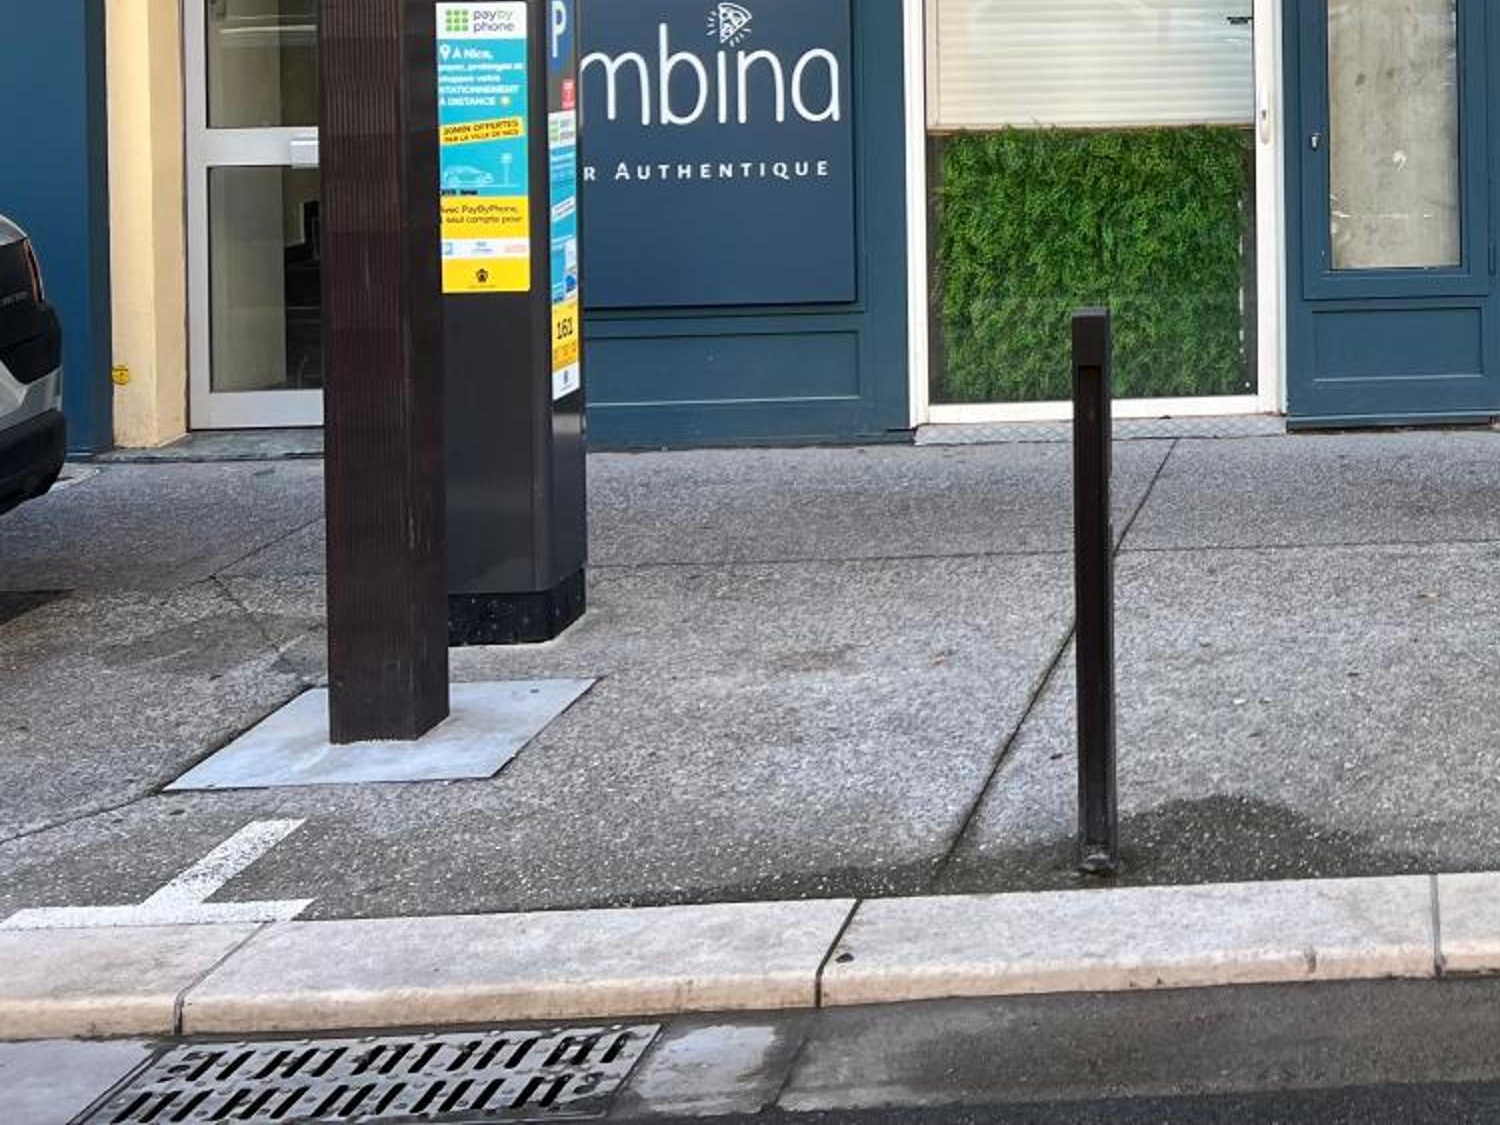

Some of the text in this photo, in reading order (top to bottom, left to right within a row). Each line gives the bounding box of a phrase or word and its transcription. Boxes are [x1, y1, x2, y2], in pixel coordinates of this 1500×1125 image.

[473, 21, 516, 34] phone
[551, 0, 568, 59] P
[580, 22, 841, 126] mbina
[614, 159, 830, 181] AUTHENTIQUE
